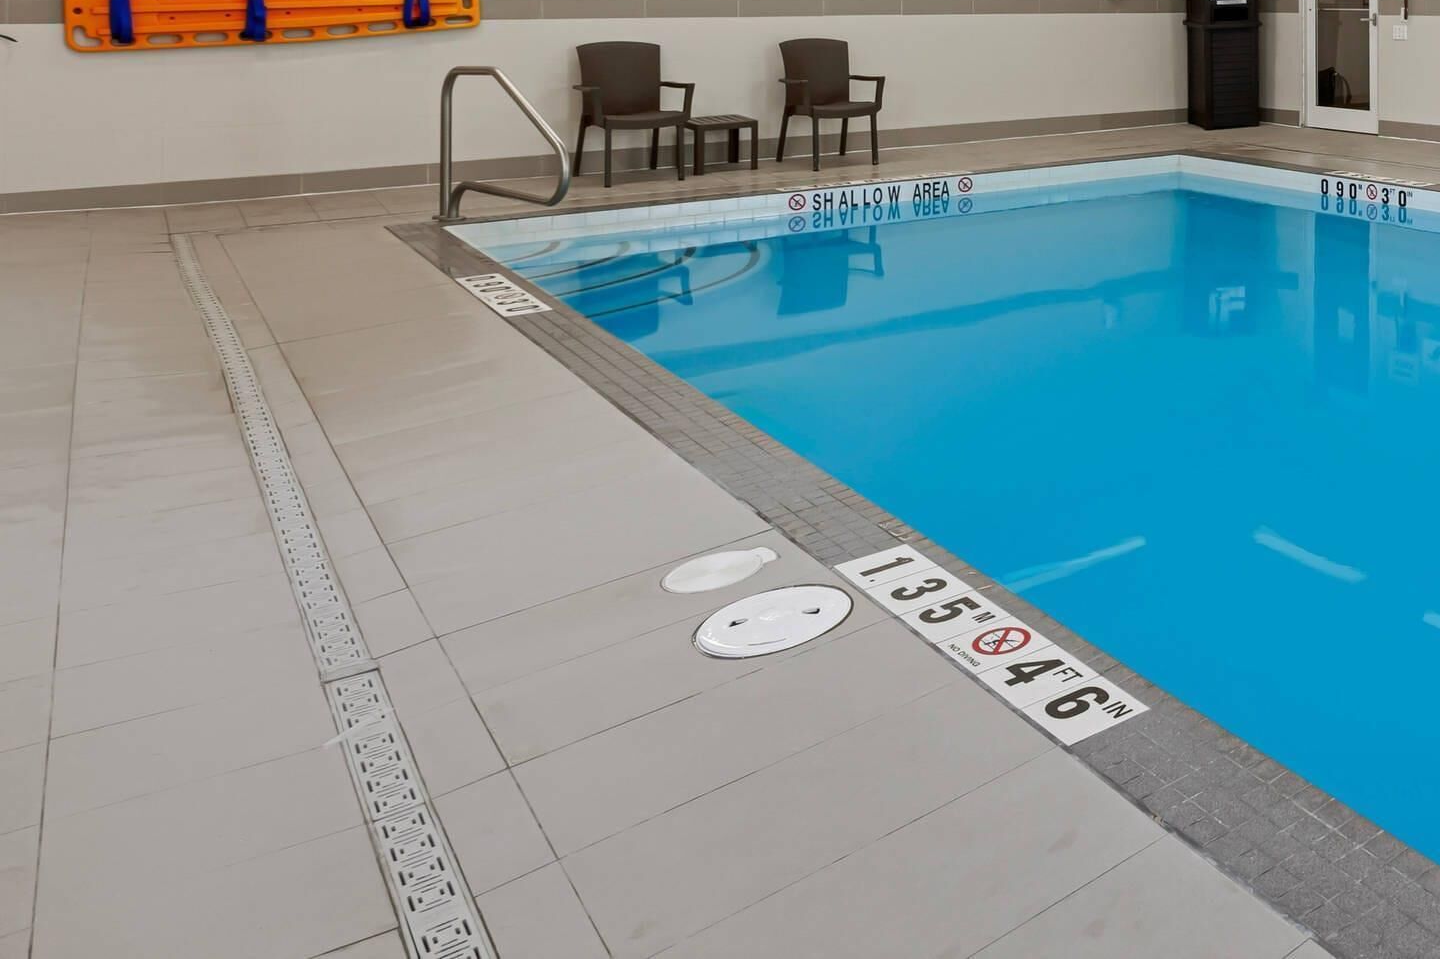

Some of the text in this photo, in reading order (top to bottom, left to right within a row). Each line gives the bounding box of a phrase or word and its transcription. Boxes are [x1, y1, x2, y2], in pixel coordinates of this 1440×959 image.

[812, 185, 901, 211] SHALLOW
[913, 180, 950, 200] AREA
[972, 611, 996, 624] M
[948, 643, 981, 667] NO DIVING
[1004, 658, 1065, 687] 4
[1052, 666, 1084, 683] FT
[1045, 686, 1110, 720] 6
[1102, 700, 1133, 720] IN
